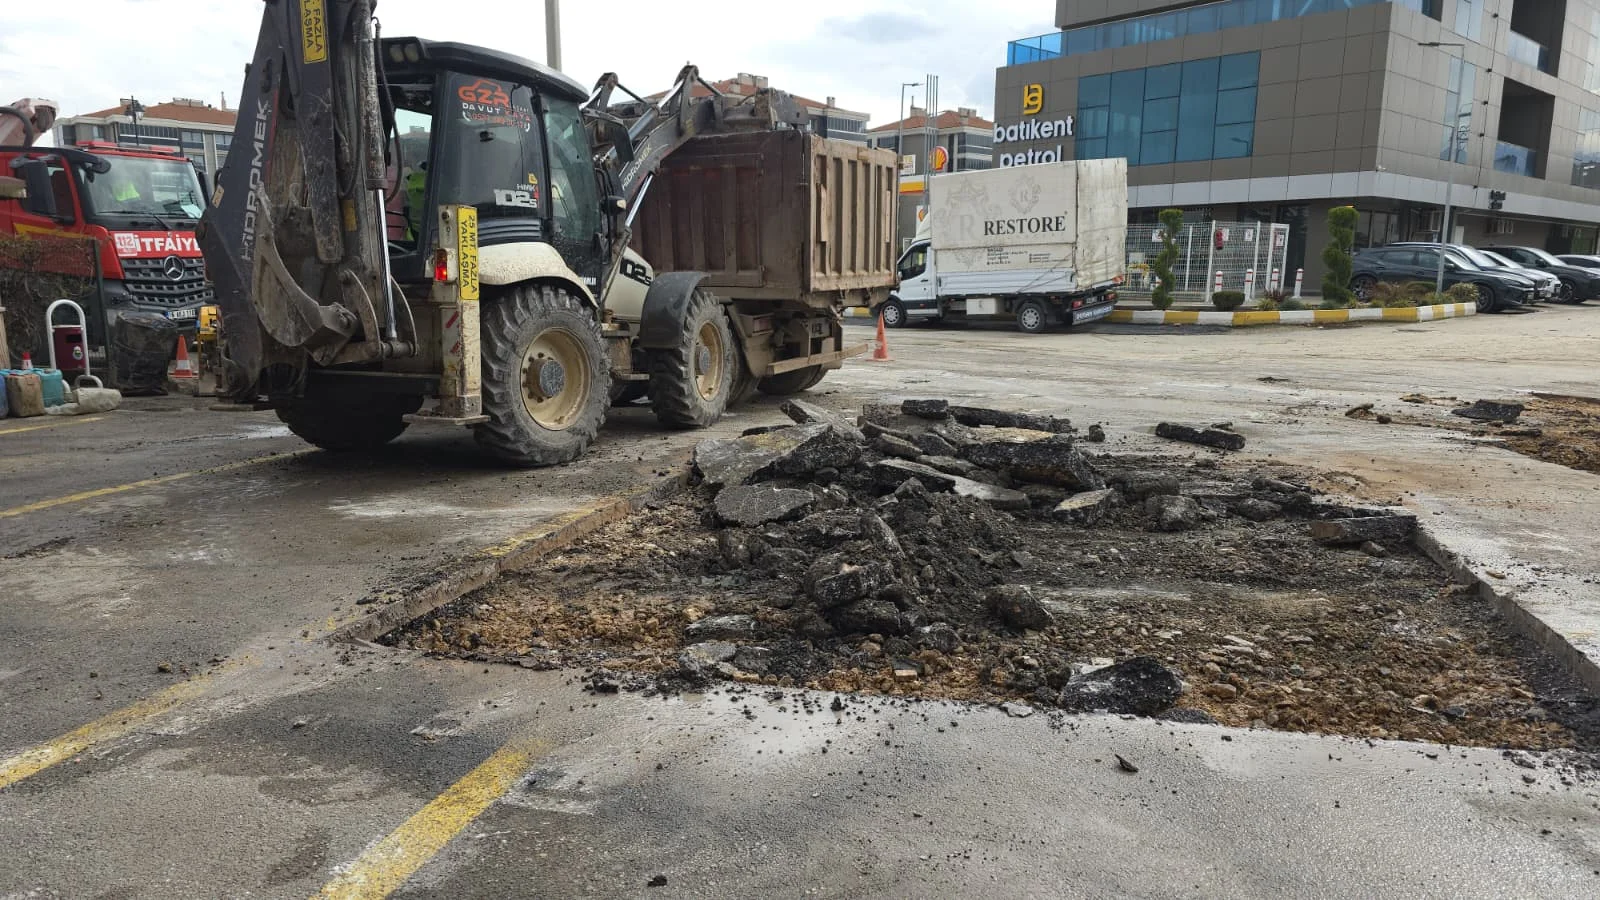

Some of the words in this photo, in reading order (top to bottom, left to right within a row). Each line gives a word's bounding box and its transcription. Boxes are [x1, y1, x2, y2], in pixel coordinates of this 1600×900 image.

[313, 8, 323, 53] FAZLA
[458, 86, 510, 108] GZR
[462, 102, 501, 115] DAVUT
[993, 116, 1074, 143] batıkent
[1000, 144, 1062, 168] petrol
[468, 215, 475, 228] 25
[984, 216, 1067, 236] RESTORE
[461, 220, 470, 288] YAKLAŞMA
[470, 255, 478, 293] FAZLA
